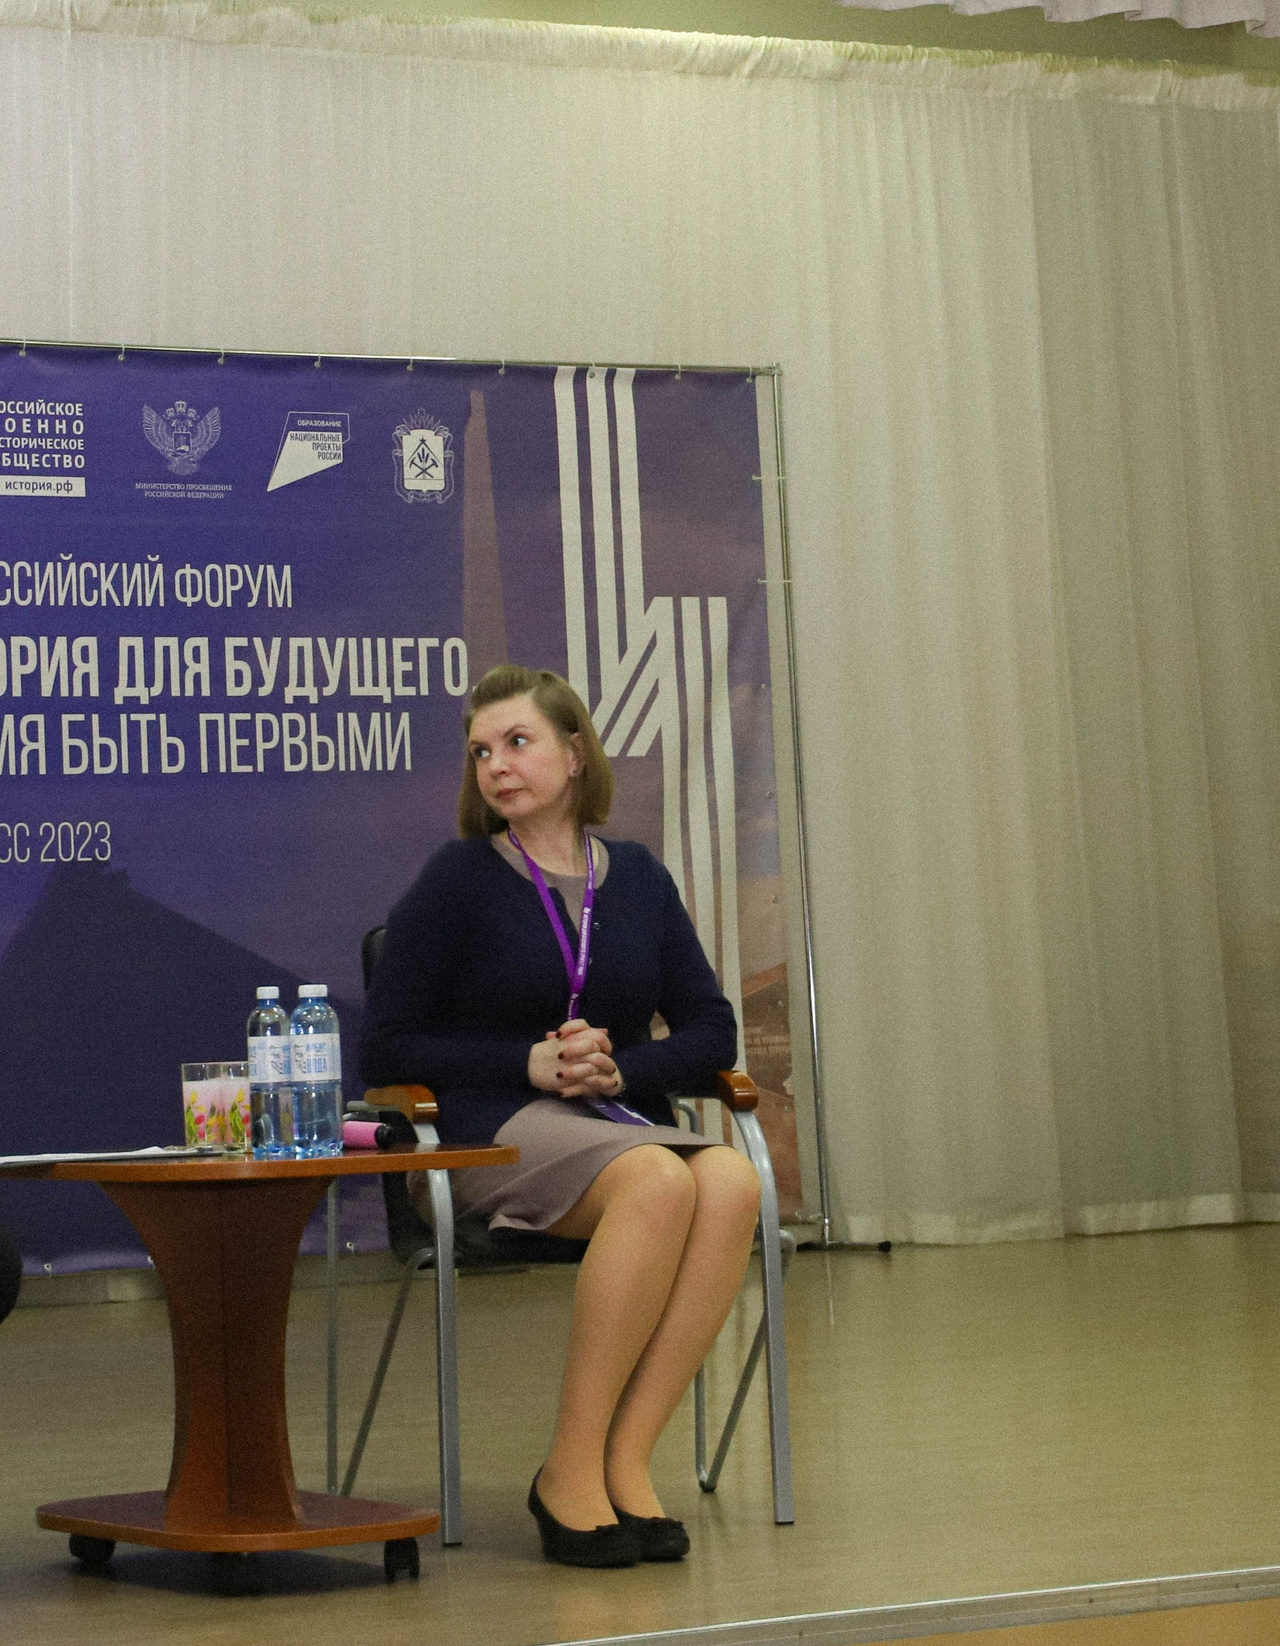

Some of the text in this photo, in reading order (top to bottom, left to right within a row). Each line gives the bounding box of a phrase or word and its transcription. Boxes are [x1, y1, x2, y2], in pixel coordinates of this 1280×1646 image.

[297, 419, 342, 428] ОБРАЗОВАНИЕ
[290, 432, 341, 442] НАЦИОНАЛЬНЫЕ
[312, 442, 341, 451] ПРОЕКТЫ
[317, 451, 341, 460] РОССИИ
[5, 480, 73, 494] история.рф
[144, 490, 224, 499] РОССИЙСКОЙ ФЕДЕРАЦИИ
[174, 563, 293, 608] ФОРУМ
[114, 636, 210, 705] ДЛЯ
[61, 713, 186, 775] БЫТЬ
[199, 712, 412, 774] ПЕРВЫМИ
[39, 821, 112, 863] 2023
